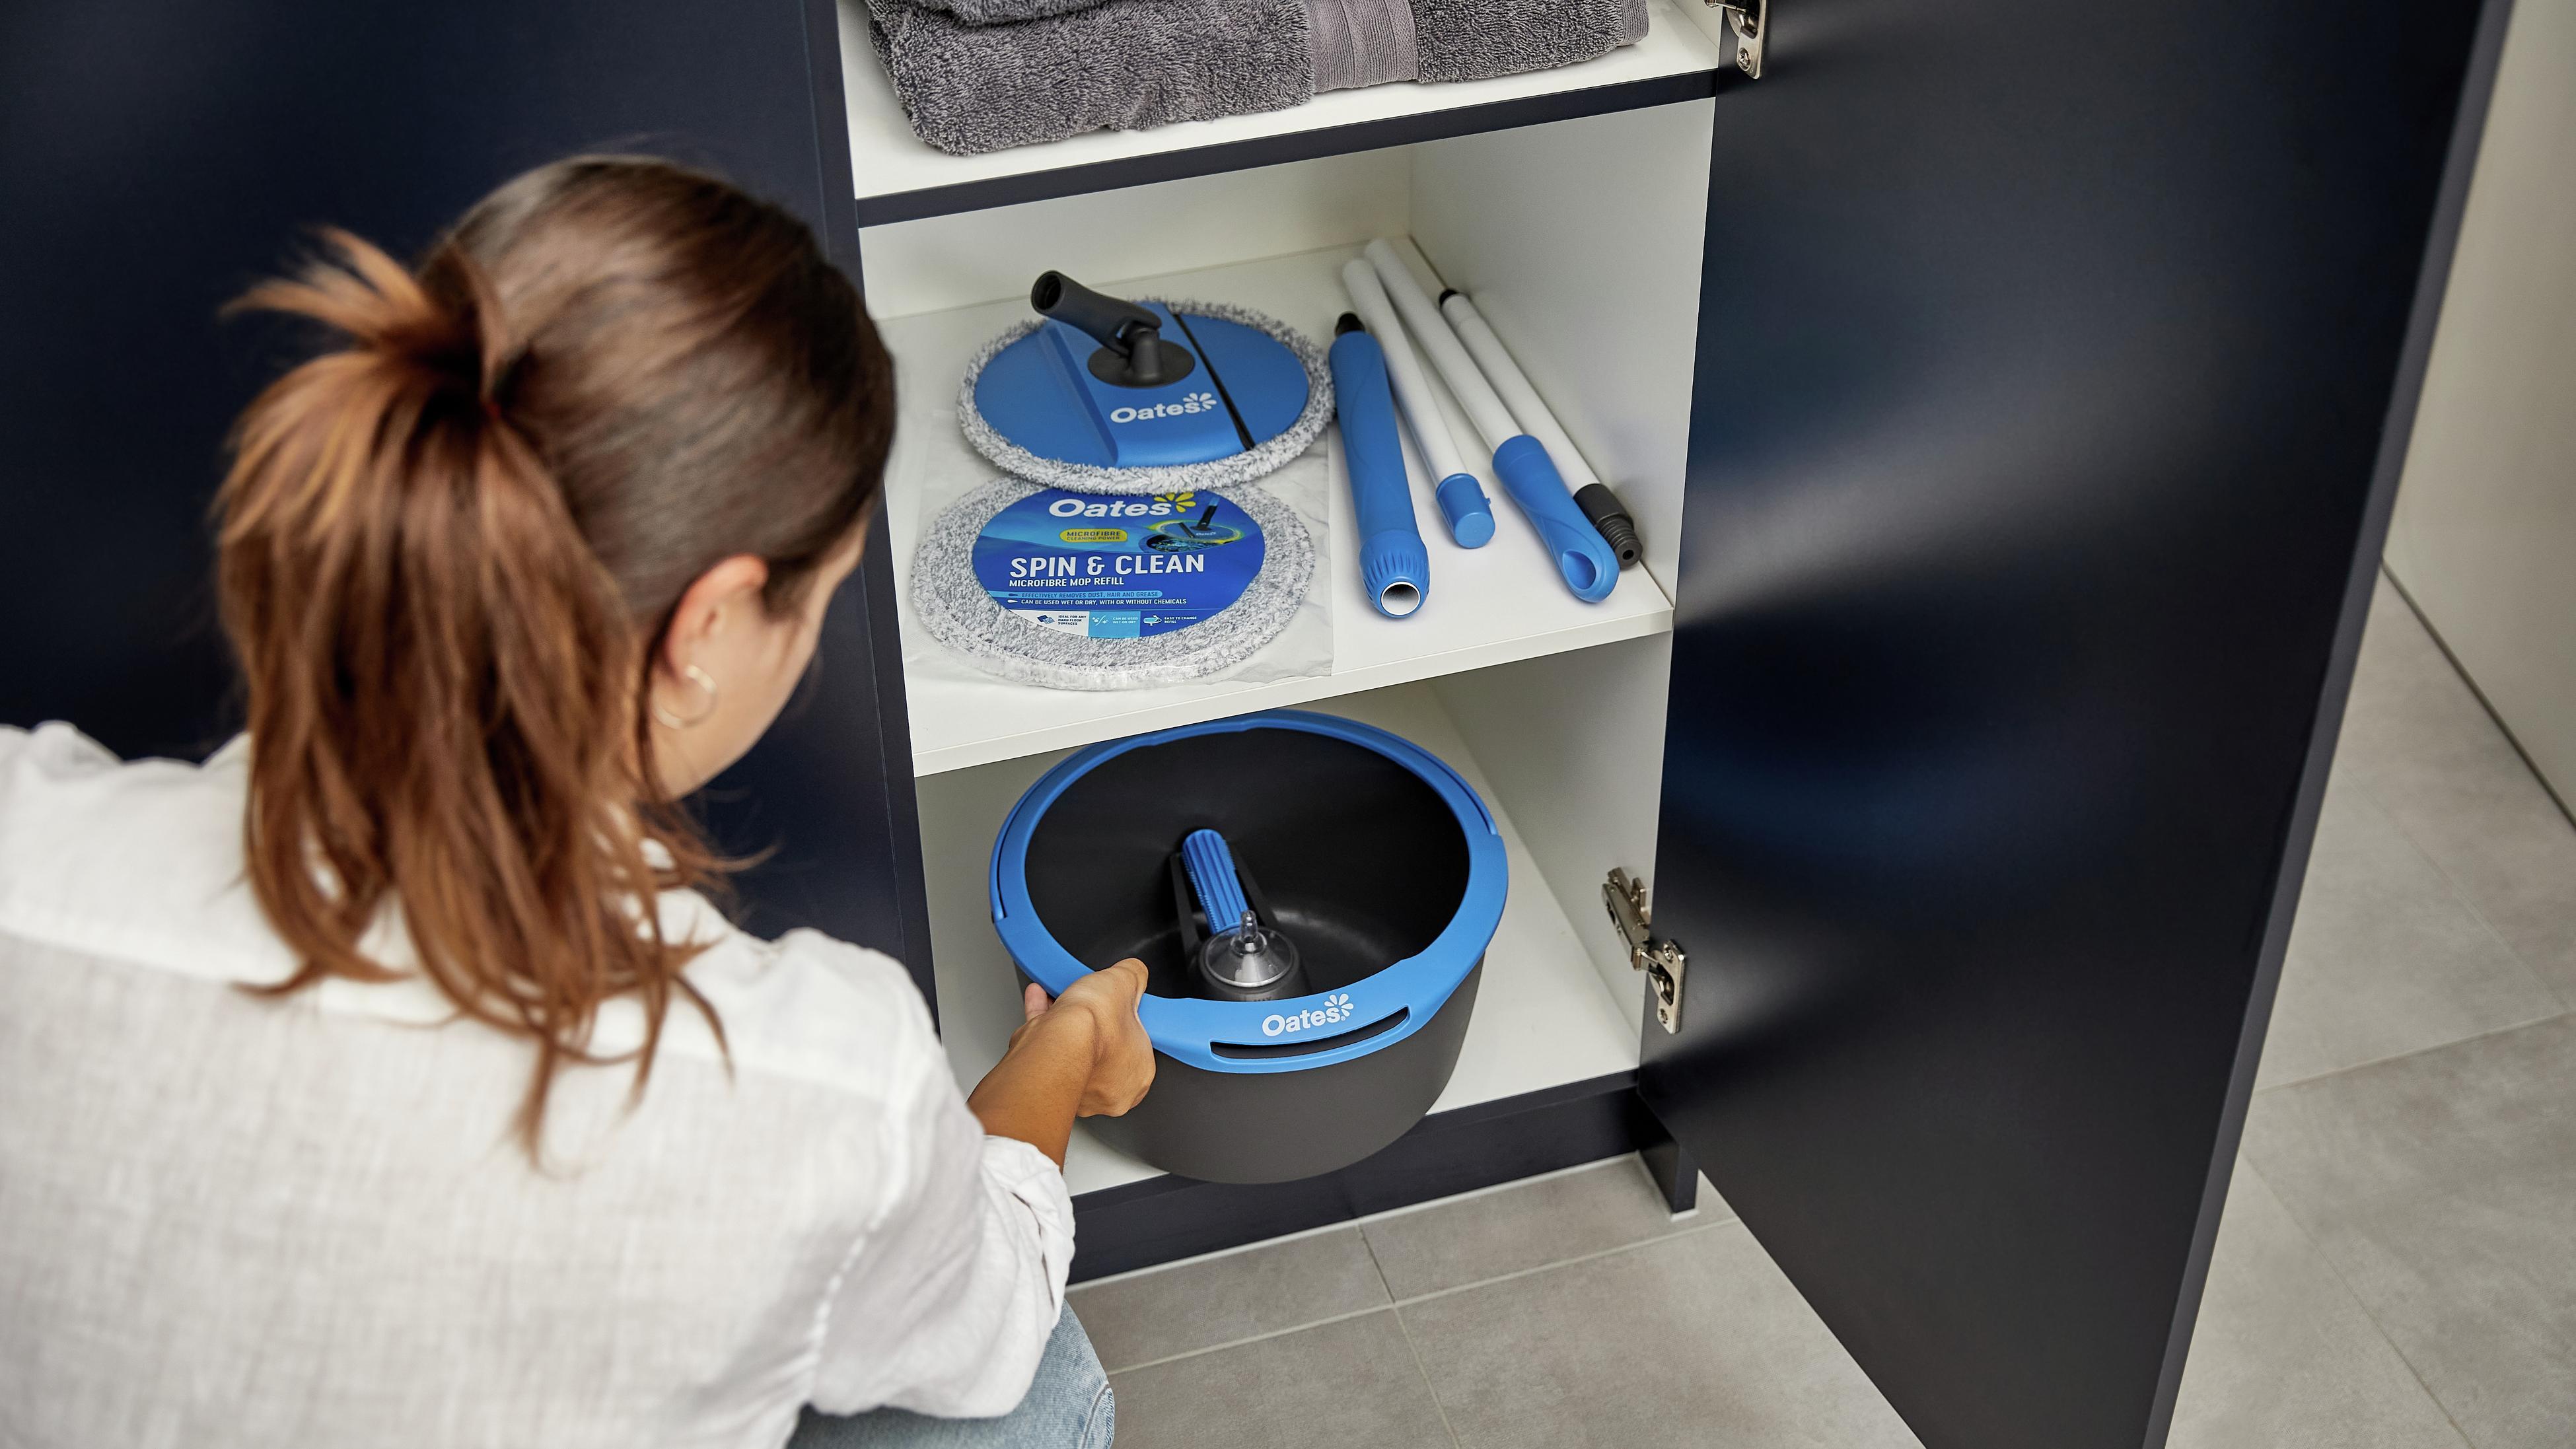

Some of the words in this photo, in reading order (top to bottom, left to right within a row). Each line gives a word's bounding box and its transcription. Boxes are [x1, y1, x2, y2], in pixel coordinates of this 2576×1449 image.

[1110, 402, 1201, 423] Oates
[1049, 499, 1172, 517] Oates
[1010, 557, 1077, 578] SPIN
[1087, 555, 1105, 576] &
[1115, 554, 1204, 575] CLEAN
[1262, 1007, 1341, 1037] Oates
